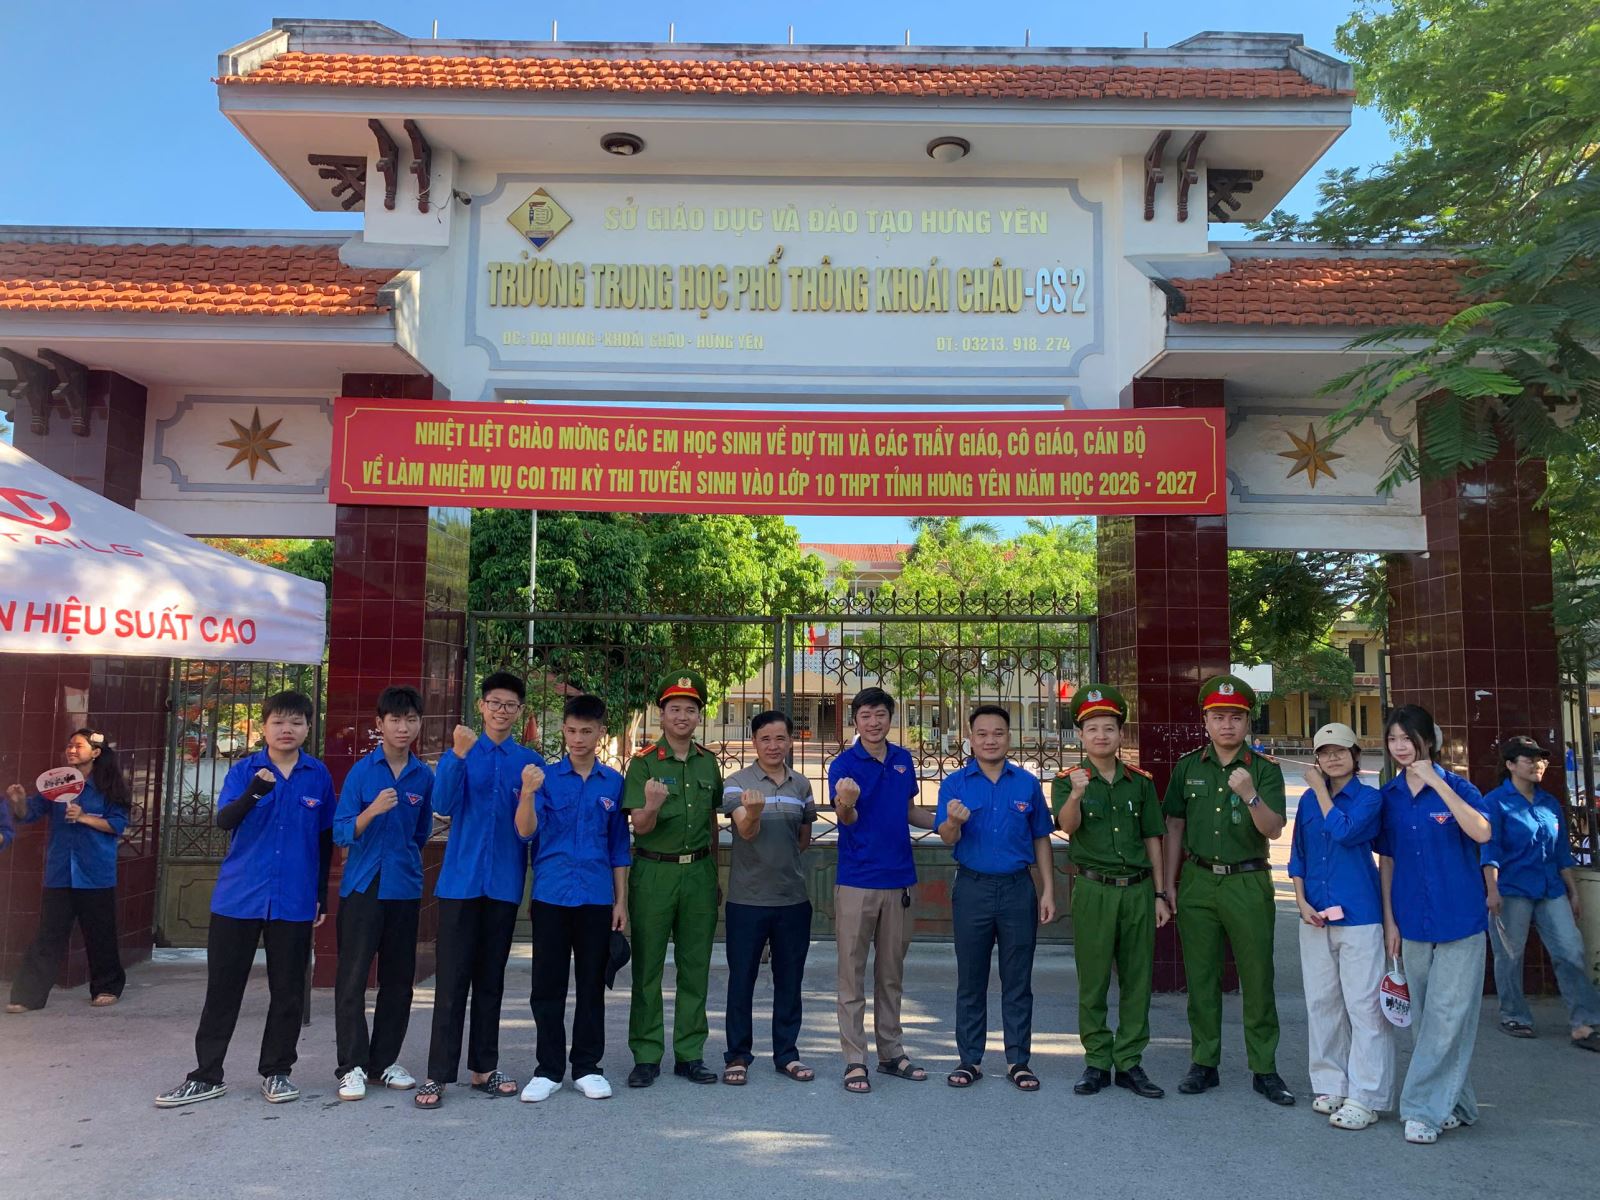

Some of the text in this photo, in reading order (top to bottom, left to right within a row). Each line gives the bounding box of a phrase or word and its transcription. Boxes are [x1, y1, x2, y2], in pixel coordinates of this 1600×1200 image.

[604, 197, 1049, 241] SỞ GIÁO DỤC VÀ ĐÀO TẠO HƯNG YÊN
[488, 250, 585, 308] TRƯỜNG
[591, 263, 673, 309] TRUNG
[679, 264, 728, 319] HỌC
[733, 245, 784, 311] PHỔ
[789, 255, 868, 313] THÔNG
[876, 256, 949, 313] KHOÁI
[557, 331, 596, 347] HƯNG
[649, 331, 685, 349] CHÂU
[697, 332, 734, 350] HƯNG
[738, 331, 764, 351] YÊN
[1046, 336, 1072, 352] 274
[415, 418, 1146, 461] NHIỆT LIỆT CHÀO MỪNG CÁC EM HỌC SINH VỀ DỰ THI VÀ CÁC THẦY GIÁO, CÔ GIÁO, CÁN BỘ
[362, 453, 383, 485] VỀ
[388, 457, 424, 486] LÀM
[429, 459, 484, 493] NHIỆM
[490, 465, 512, 494] VỤ
[517, 466, 545, 490] COI
[550, 467, 576, 491] THI
[581, 464, 603, 491] KỲ
[608, 469, 634, 492] THI
[639, 461, 692, 494] TUYỂN
[696, 471, 736, 495] SINH
[742, 467, 774, 495] VÀO
[779, 467, 810, 496] LỚP
[815, 473, 835, 497] 10
[840, 473, 879, 497] THPT
[884, 465, 922, 497] TỈNH
[927, 471, 973, 497] HƯNG
[978, 468, 1011, 497] YÊN
[1016, 468, 1055, 496] NĂM
[1060, 472, 1093, 501] HỌC
[1099, 471, 1139, 495] 2026
[1156, 471, 1197, 495] 2027
[24, 595, 106, 642] HIỆU
[115, 604, 194, 641] SUẤT
[200, 616, 257, 645] CAO
